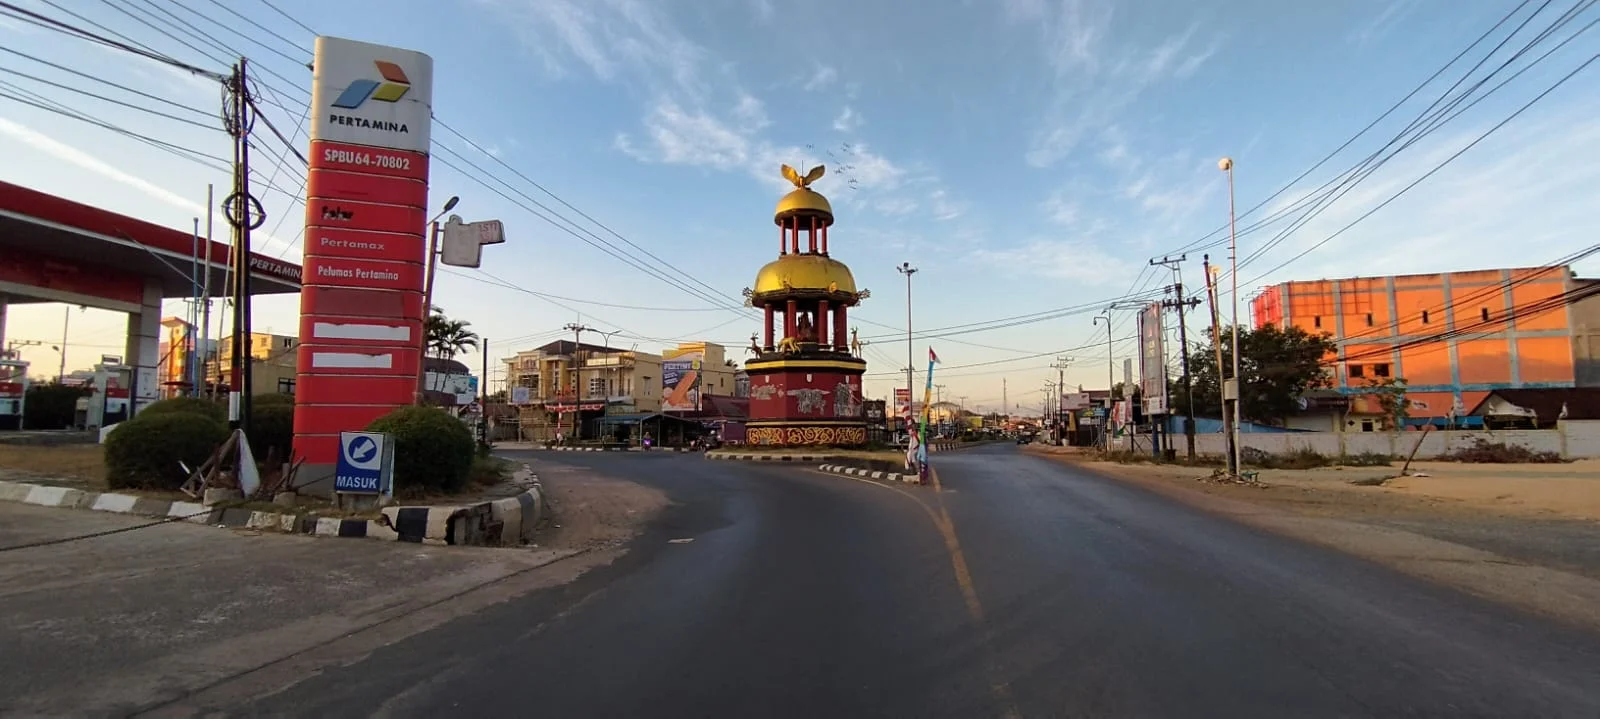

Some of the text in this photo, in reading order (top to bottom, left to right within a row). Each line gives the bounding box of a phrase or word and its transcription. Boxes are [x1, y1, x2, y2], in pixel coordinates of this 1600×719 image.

[329, 114, 409, 134] PERTAMINA
[320, 237, 385, 251] Pertamax
[250, 257, 303, 280] PERTAMIN
[317, 265, 399, 281] Pelumas Pertamina
[336, 475, 378, 489] MASUK
